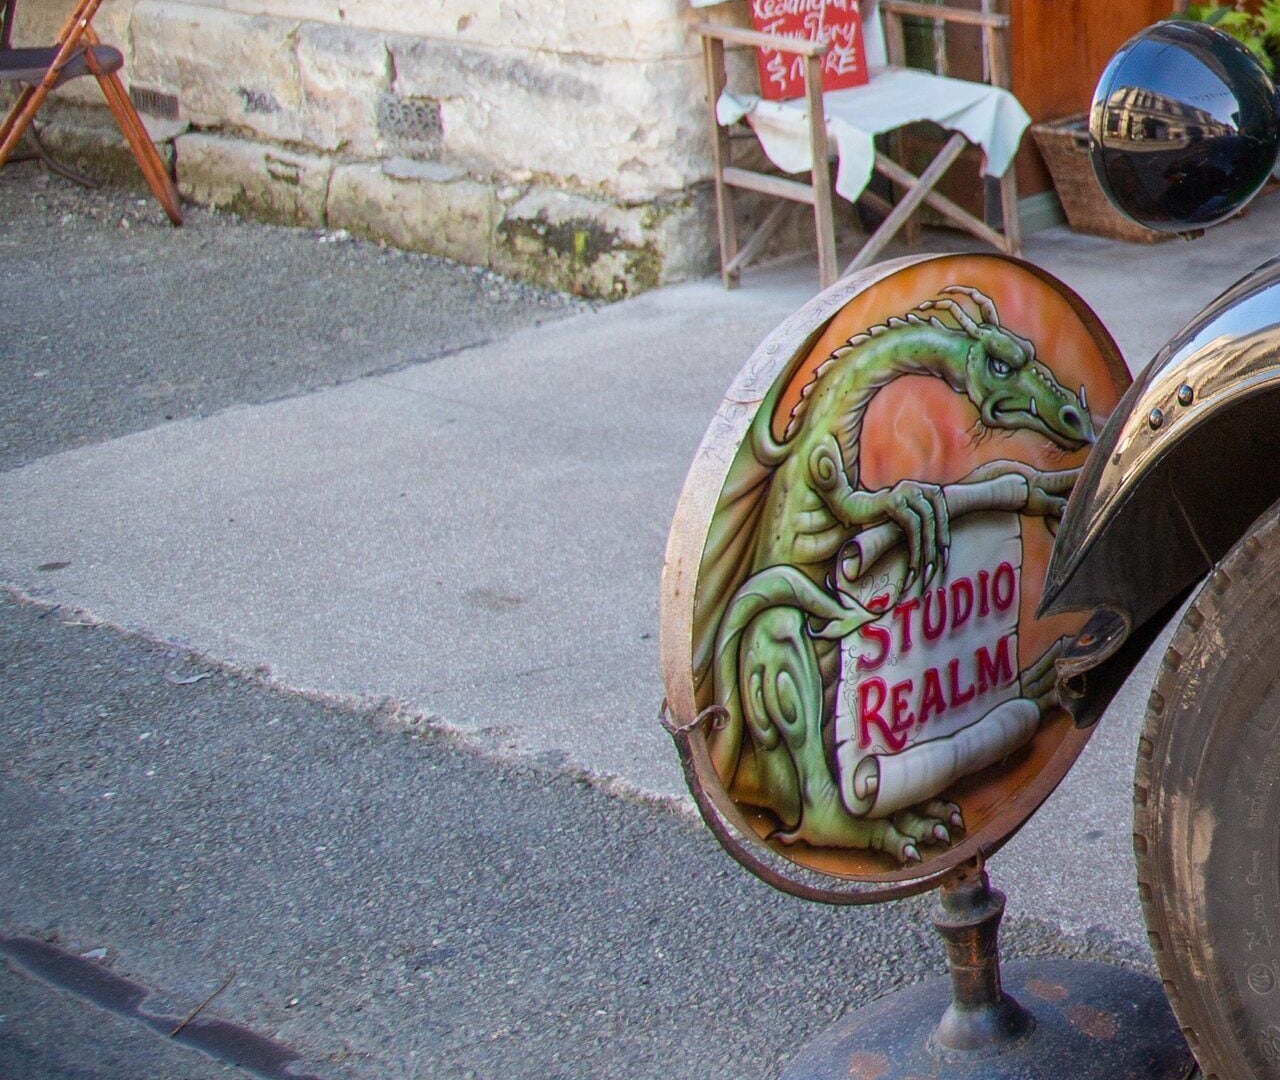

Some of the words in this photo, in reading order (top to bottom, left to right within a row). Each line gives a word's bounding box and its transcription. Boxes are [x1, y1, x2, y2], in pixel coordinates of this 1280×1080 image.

[789, 43, 858, 81] MRE
[856, 560, 1017, 672] STUDIO
[866, 633, 1014, 752] REALM
